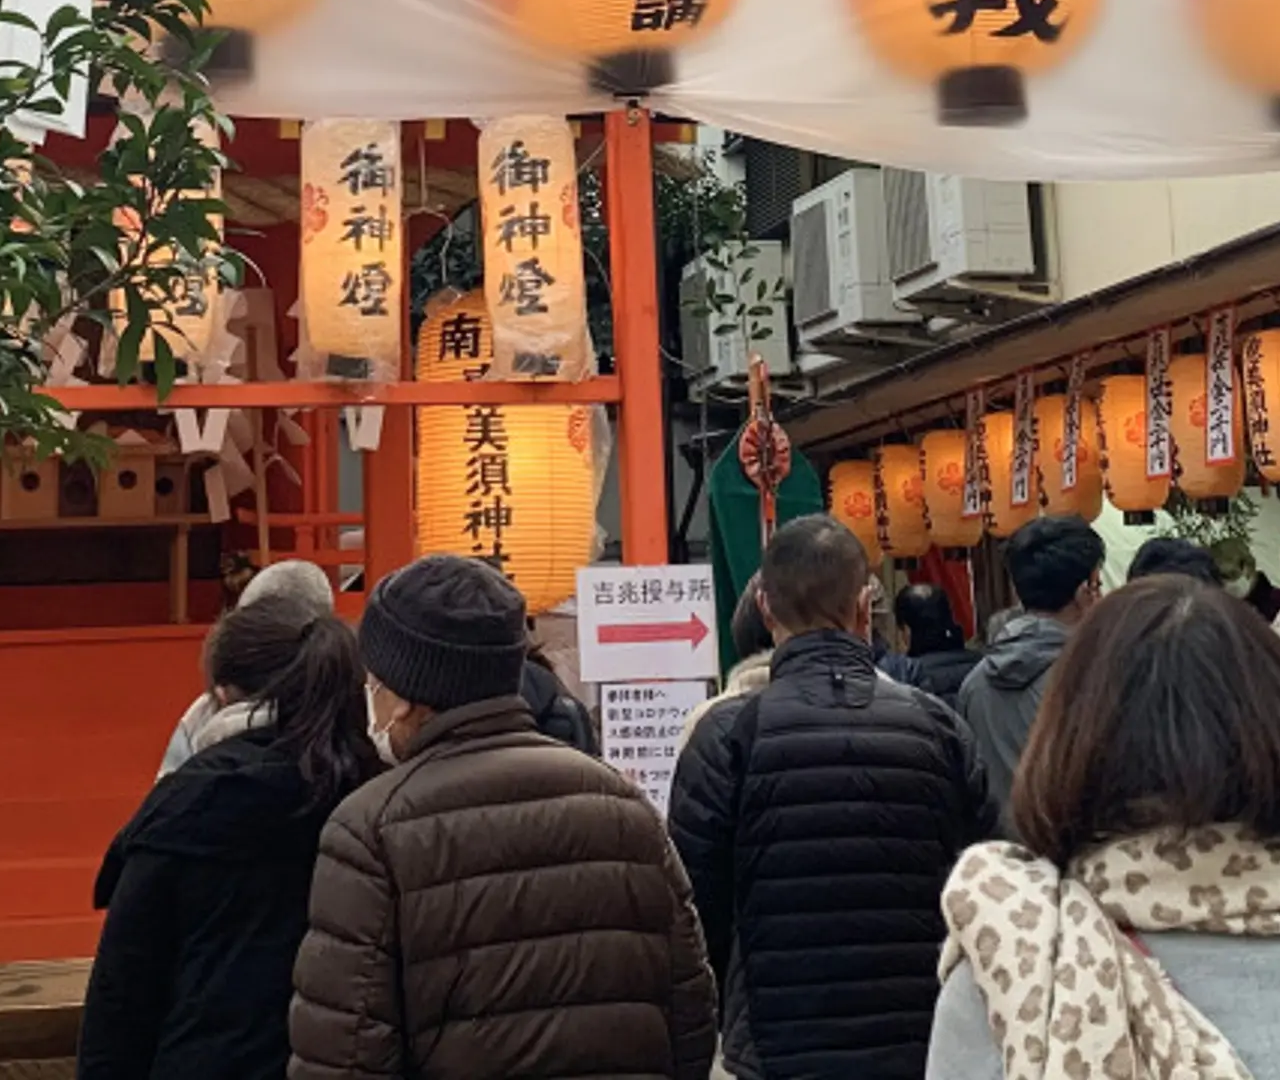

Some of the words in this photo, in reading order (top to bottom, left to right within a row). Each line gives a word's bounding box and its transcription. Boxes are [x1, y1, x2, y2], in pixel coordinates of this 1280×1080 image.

[593, 578, 711, 604] 吉兆授与所
